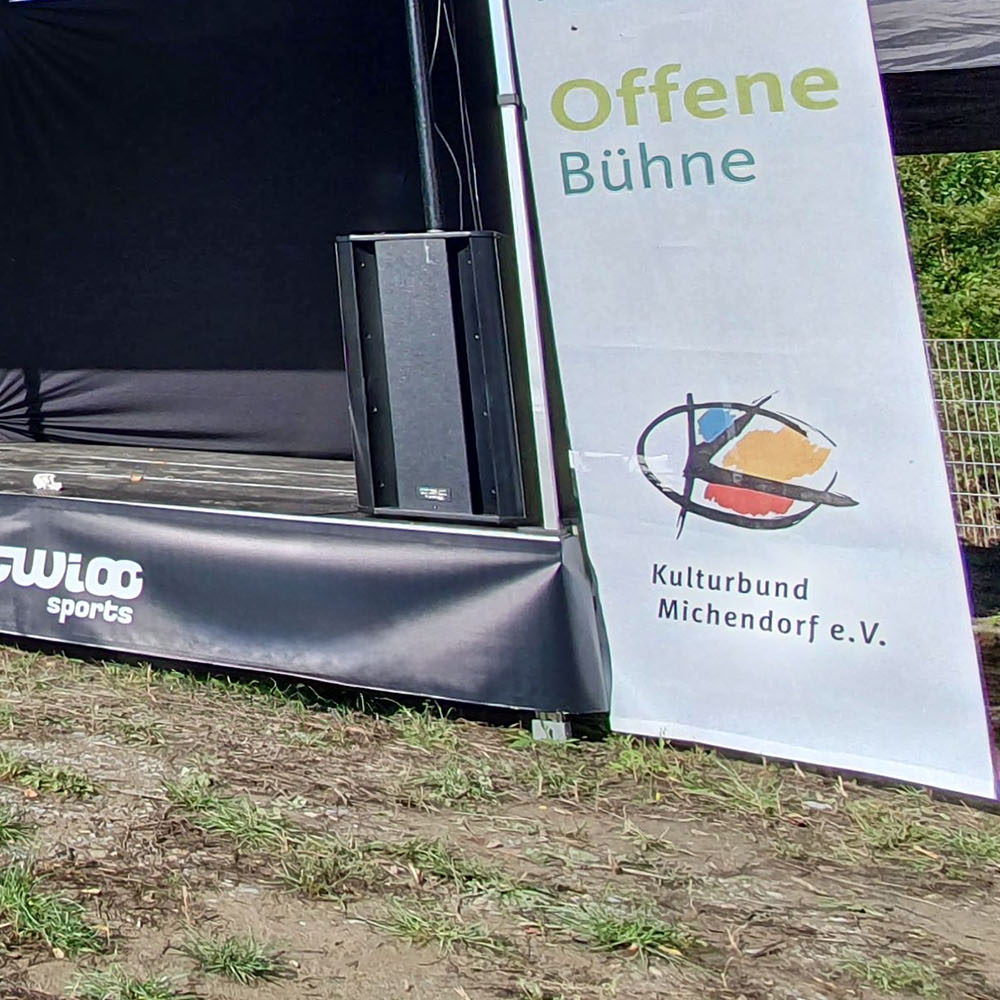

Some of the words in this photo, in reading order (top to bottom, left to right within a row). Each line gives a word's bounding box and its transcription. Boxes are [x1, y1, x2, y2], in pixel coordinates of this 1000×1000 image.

[551, 63, 840, 132] Offene
[560, 142, 756, 196] Bühne
[651, 563, 810, 600] Kulturbund
[46, 596, 134, 625] sports
[657, 597, 820, 644] Michendorf
[829, 620, 887, 647] e.V.
